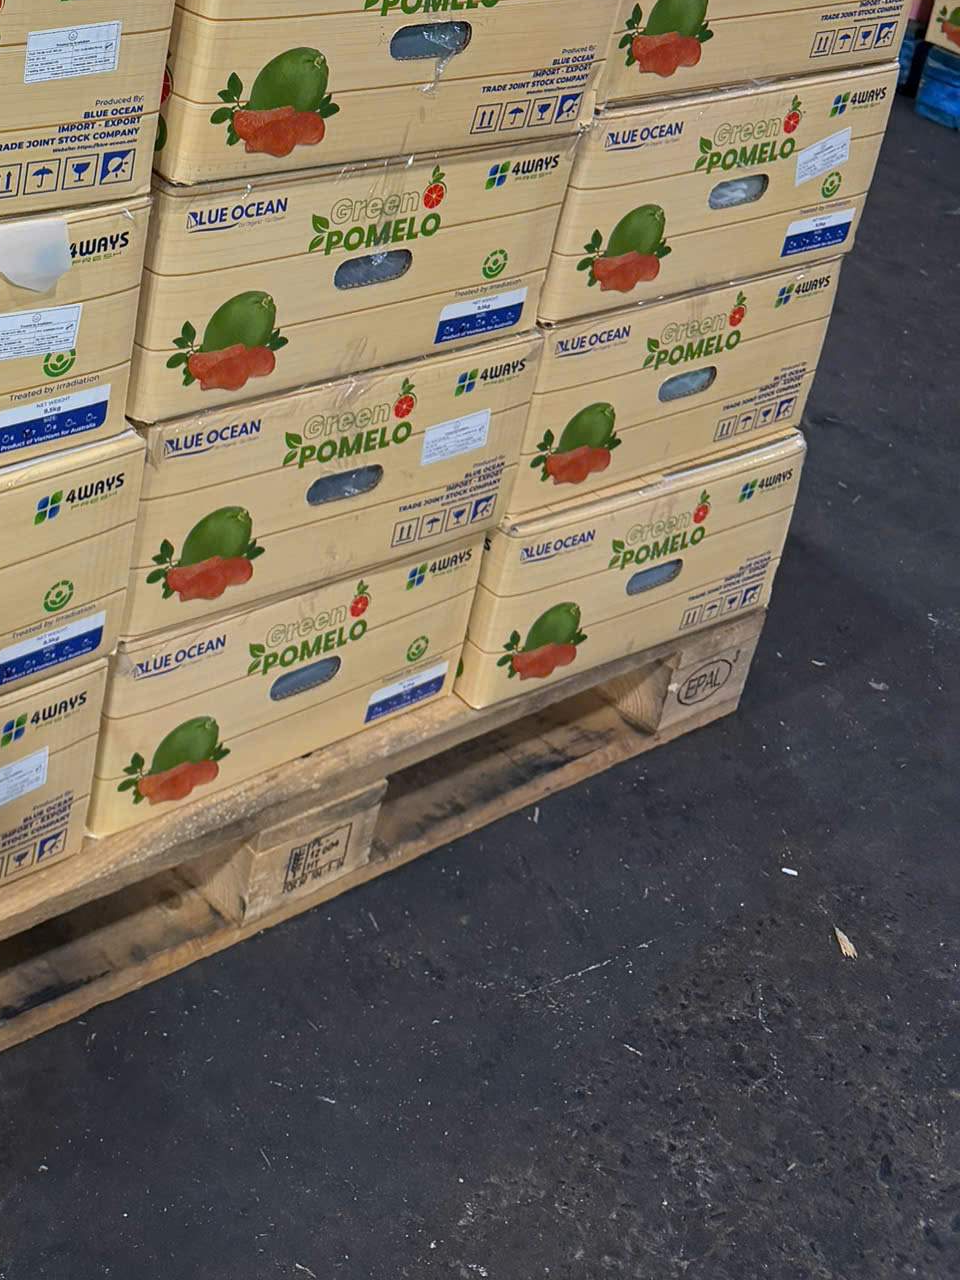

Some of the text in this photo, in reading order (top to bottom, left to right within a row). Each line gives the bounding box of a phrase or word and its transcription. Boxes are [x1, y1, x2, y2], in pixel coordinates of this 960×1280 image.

[84, 105, 143, 119] BLUE OCEAN
[850, 86, 887, 107] 4WAYS
[26, 138, 56, 148] JOINT
[58, 134, 90, 144] STOCK
[93, 128, 140, 140] COMPANY
[58, 116, 142, 133] IMPORT EXPORT
[605, 121, 684, 147] BLUE OCEAN
[713, 116, 782, 148] Green
[512, 153, 560, 176] 4WAYS
[706, 137, 796, 174] POMELO
[186, 197, 288, 229] BLUE OCEAN
[330, 189, 422, 226] Green
[69, 230, 129, 259] 4WAYS
[324, 212, 441, 256] POMELO
[794, 275, 831, 296] 4WAYS
[588, 325, 631, 347] OCEAN
[660, 310, 729, 345] Green
[653, 330, 742, 370] POMELO
[479, 358, 526, 382] 4WAYS
[9, 374, 100, 401] Treated by Irradiation
[303, 402, 392, 440] Green
[163, 419, 262, 457] BLUE OCEAN
[297, 421, 413, 469] POMELO
[65, 472, 125, 505] 4WAYS
[758, 469, 793, 489] 4WAYS
[553, 529, 596, 553] OCEAN
[619, 526, 706, 570] POMELO
[429, 548, 472, 575] 4WAYS
[265, 604, 348, 648] Green
[174, 634, 227, 665] OCEAN
[261, 619, 368, 675] POMELO
[686, 666, 722, 701] EPAL
[30, 691, 88, 726] 4WAYS
